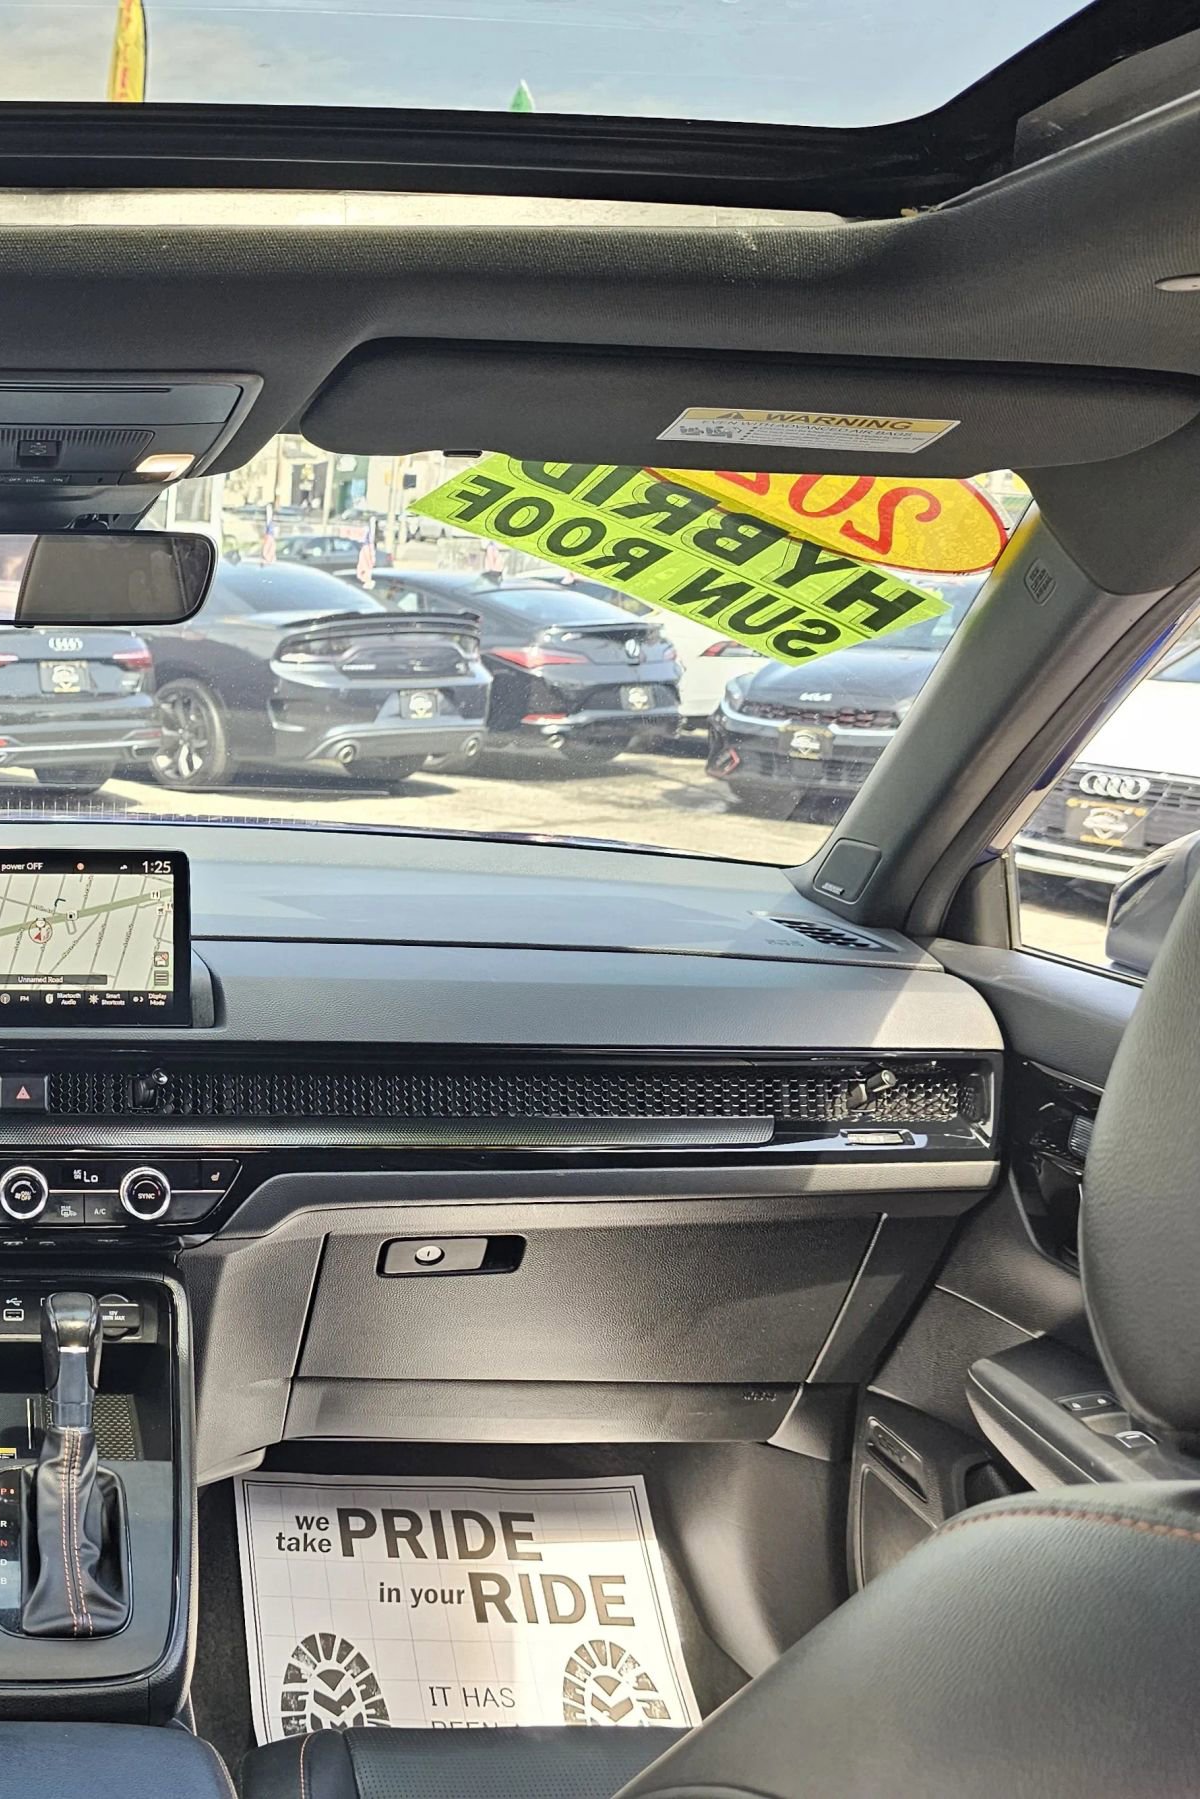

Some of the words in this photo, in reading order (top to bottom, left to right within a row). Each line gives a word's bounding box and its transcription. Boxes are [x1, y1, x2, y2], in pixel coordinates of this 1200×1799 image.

[742, 420, 775, 428] WITH
[775, 422, 843, 433] ADVANCED
[766, 413, 914, 430] WARNING
[1, 863, 25, 873] power
[26, 862, 44, 870] OFF
[142, 860, 171, 873] 1:25
[83, 1170, 99, 1183] Lo
[137, 1192, 156, 1200] SYNC
[94, 1208, 107, 1216] A/C
[0, 1520, 8, 1528] R
[295, 1515, 330, 1531] we
[276, 1532, 332, 1553] take
[336, 1507, 543, 1562] PRIDE
[0, 1539, 8, 1547] N
[0, 1577, 8, 1585] B
[378, 1582, 401, 1603] in
[410, 1585, 465, 1608] your
[467, 1571, 635, 1627] RIDE
[429, 1686, 451, 1707] IT
[463, 1686, 516, 1709] HAS
